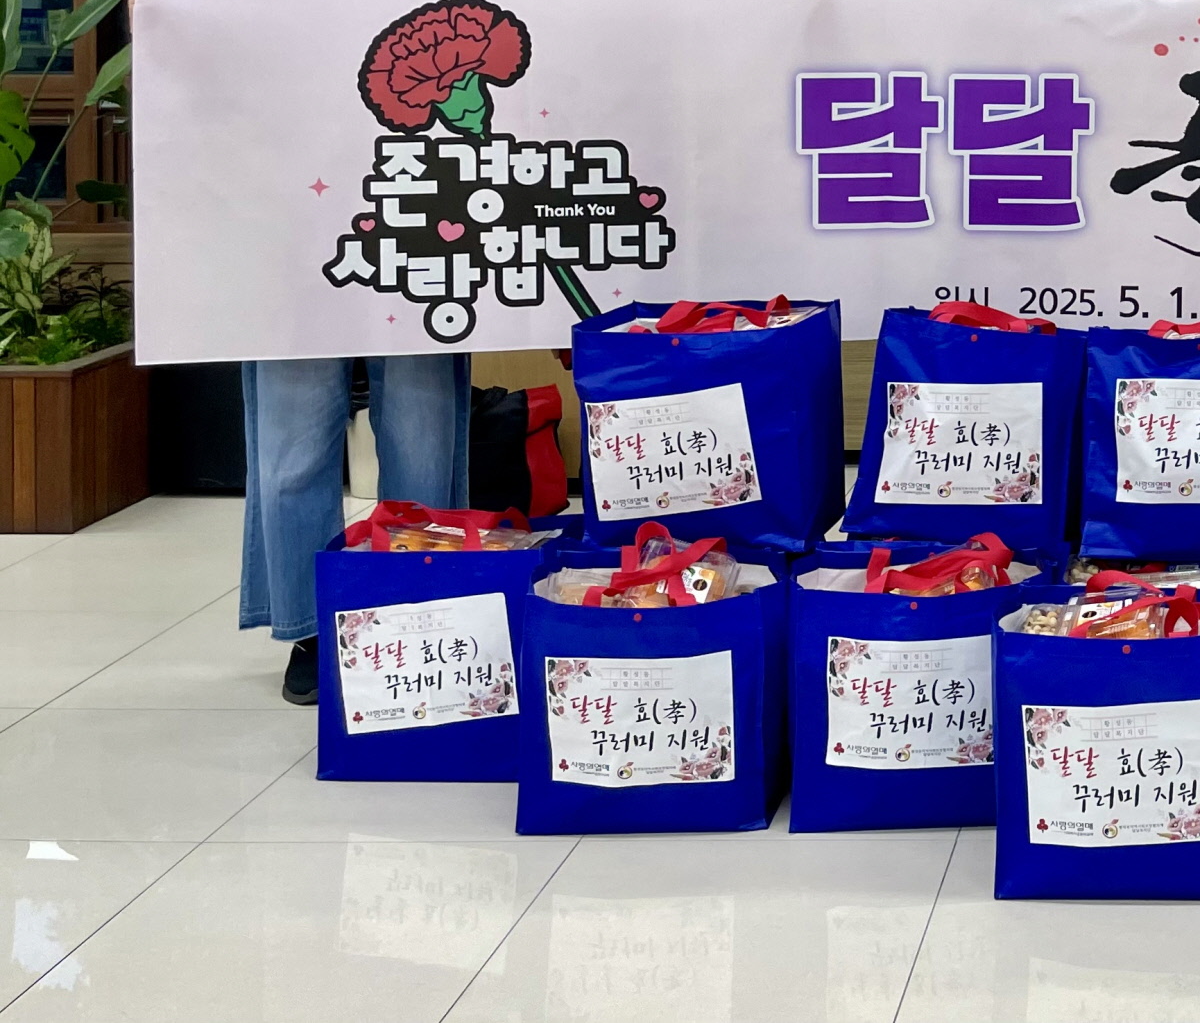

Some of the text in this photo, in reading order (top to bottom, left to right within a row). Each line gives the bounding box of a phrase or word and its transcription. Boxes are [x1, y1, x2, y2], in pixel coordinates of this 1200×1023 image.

[797, 72, 1094, 230] 달달
[369, 140, 631, 227] 존경하고
[534, 203, 616, 218] Thank You
[330, 222, 669, 337] 사랑합니다
[1019, 287, 1103, 317] 2025.
[1119, 286, 1149, 318] 5.
[905, 417, 1010, 446] 달달 효(孝)
[1138, 413, 1180, 442] 달달
[604, 428, 717, 462] 달달 효(孝)
[627, 454, 733, 490] 꾸러미 지원
[915, 450, 1021, 475] 꾸러미 지원
[363, 636, 478, 671] 달달 효(孝)
[384, 663, 493, 699] 꾸러미 지원
[851, 677, 975, 708] 달달 효(孝)
[570, 695, 697, 725] 달달 효(孝)
[870, 708, 987, 738] 꾸러미 지원
[591, 726, 709, 756] 꾸러미 지원
[1050, 746, 1183, 778] 달달 효(孝)
[1073, 780, 1198, 813] 꾸러미 지원
